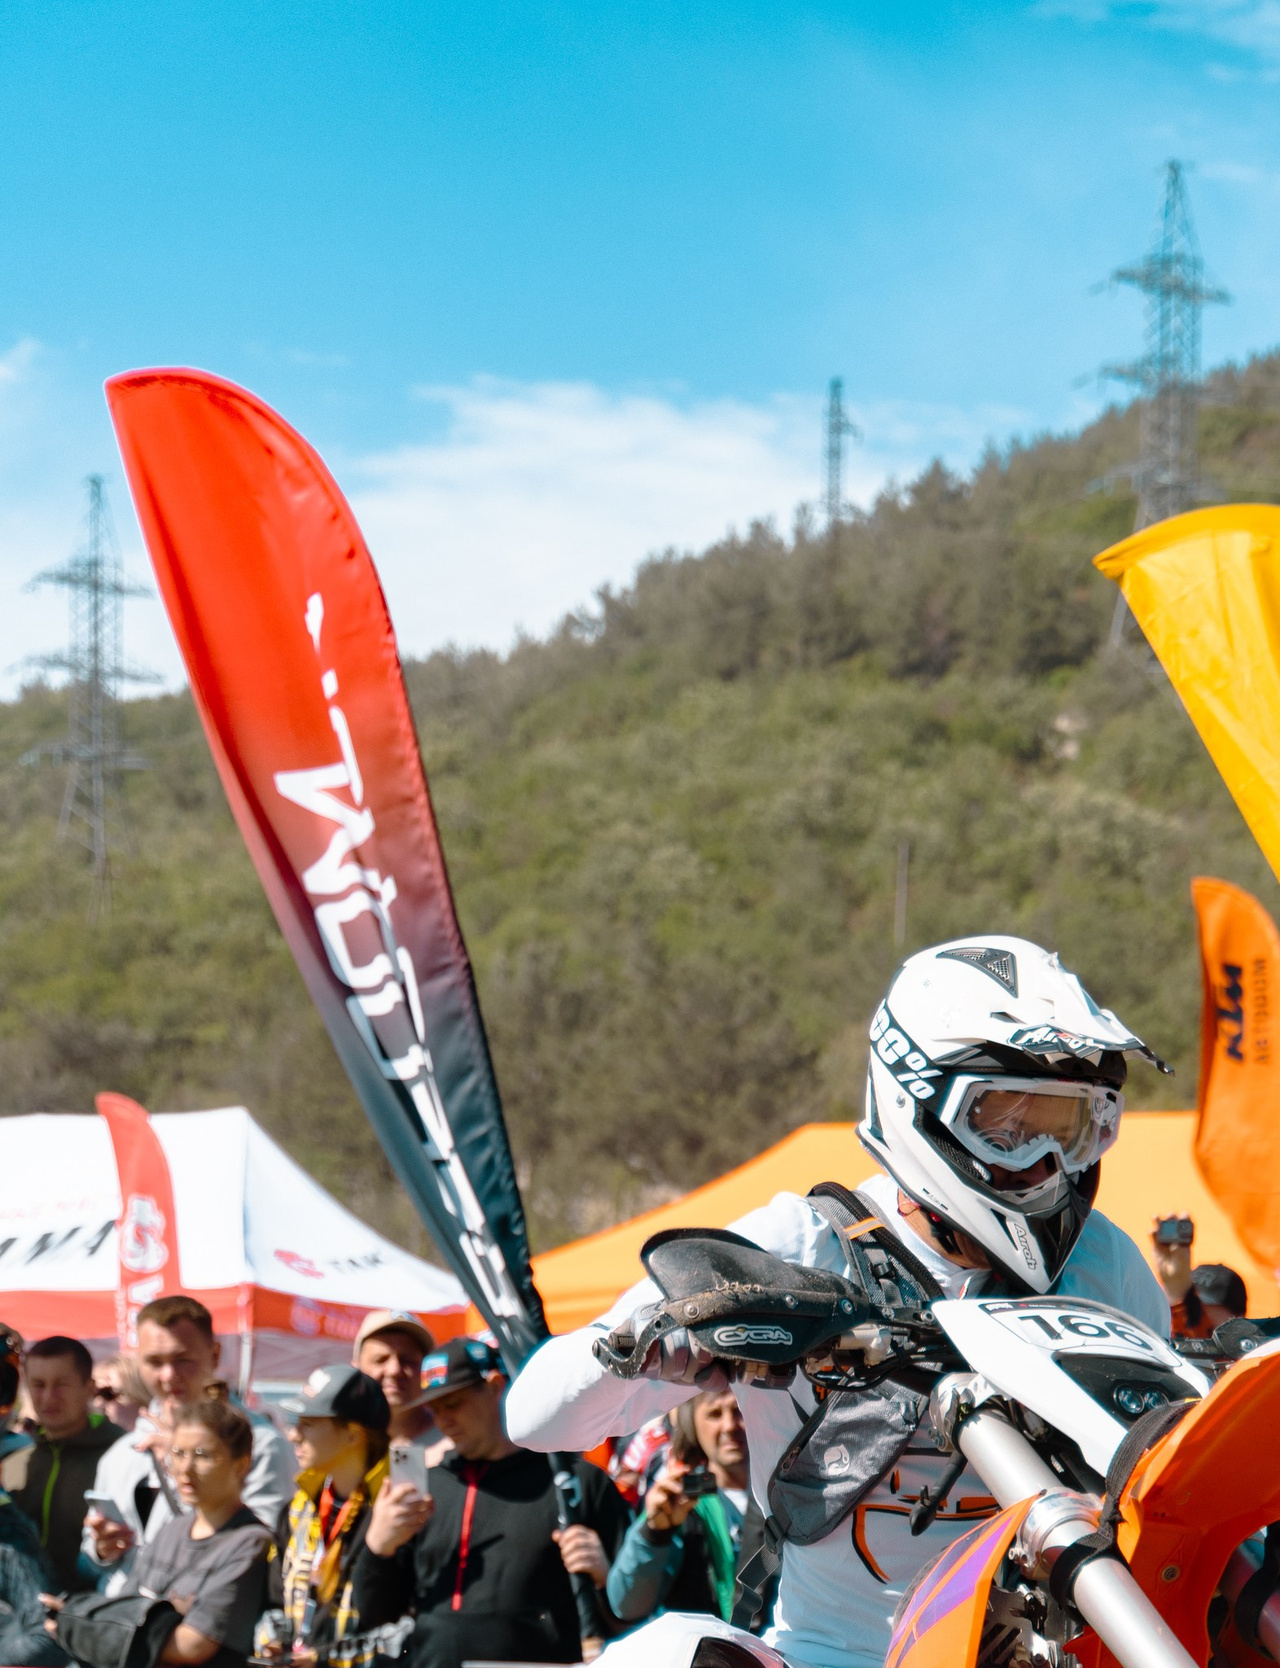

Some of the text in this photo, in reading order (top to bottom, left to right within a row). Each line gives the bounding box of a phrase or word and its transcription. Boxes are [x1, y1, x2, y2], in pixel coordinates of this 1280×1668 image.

[870, 998, 943, 1100] 00%
[1014, 1223, 1037, 1270] Airoh
[719, 1329, 788, 1342] CYCRA
[1018, 1314, 1153, 1351] 166
